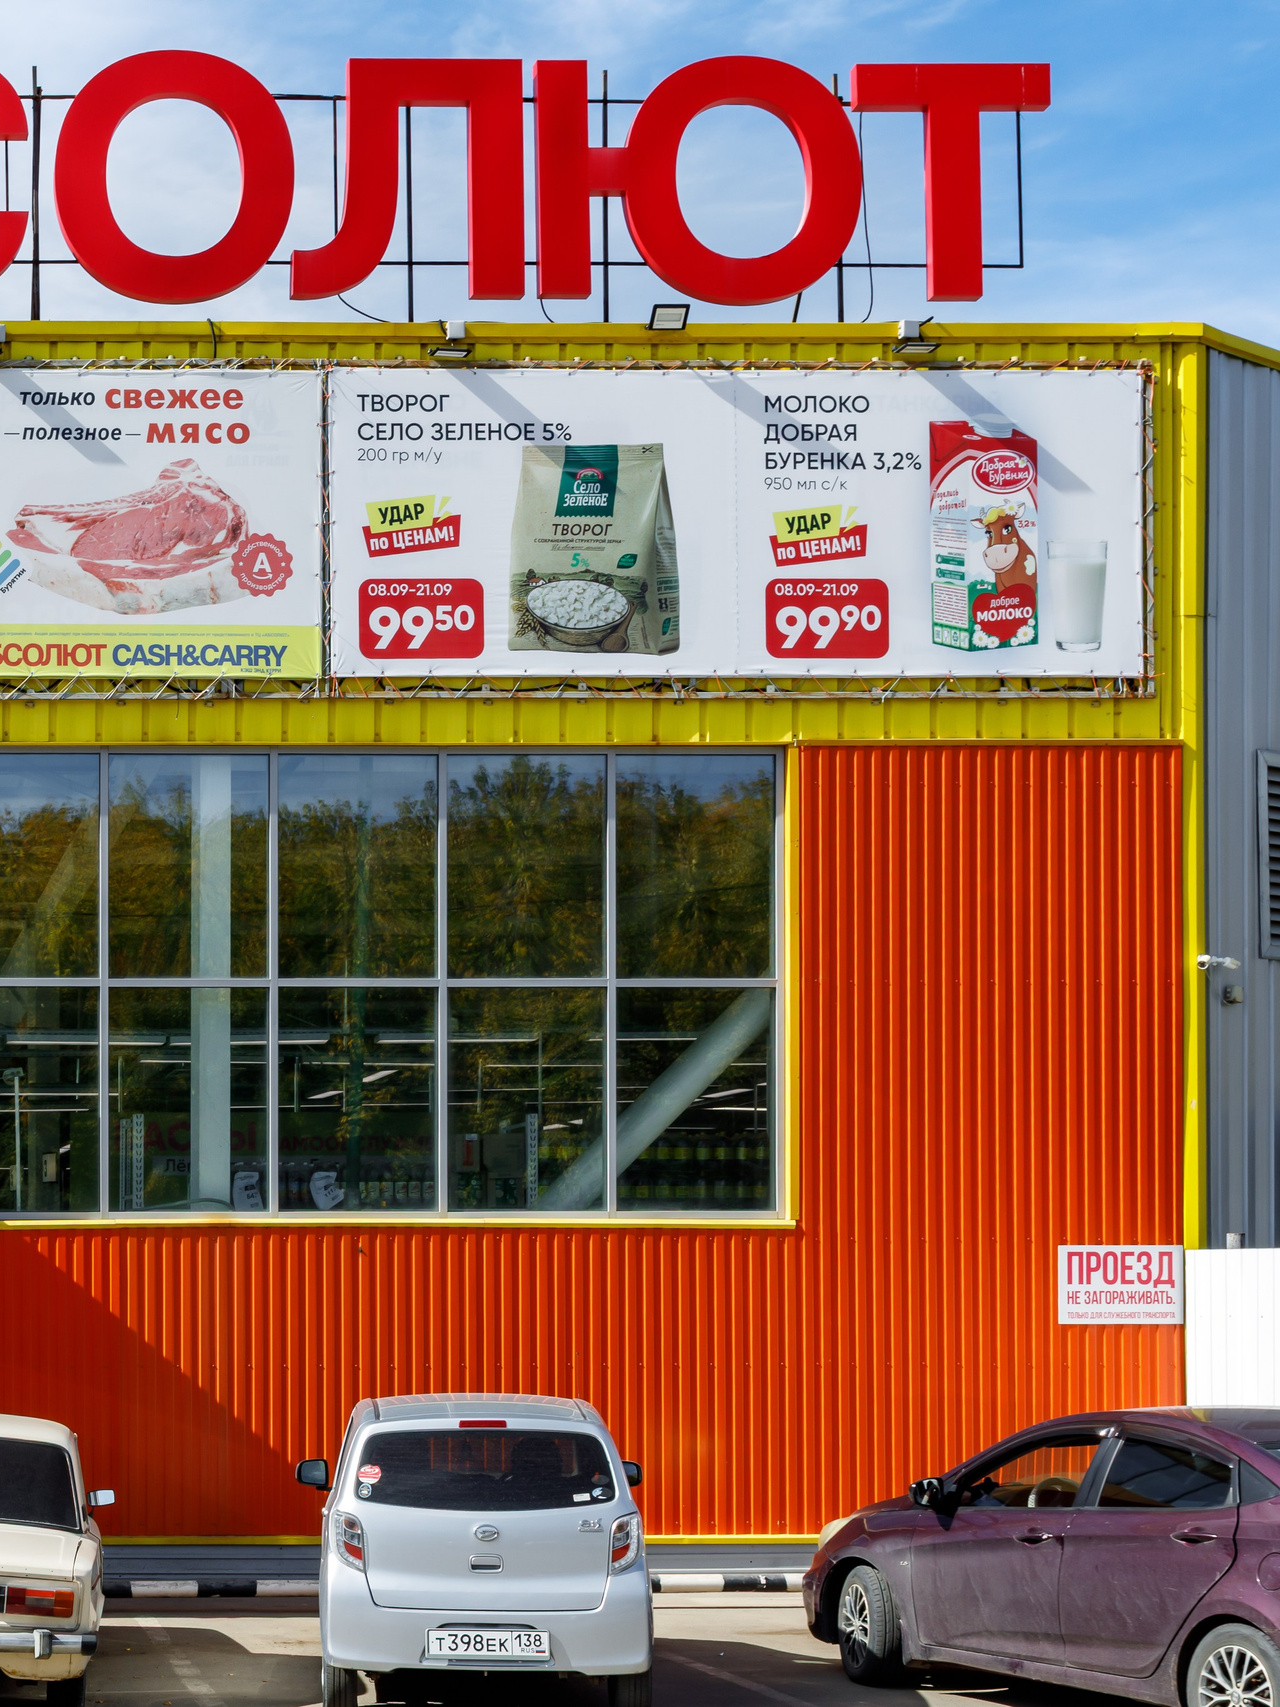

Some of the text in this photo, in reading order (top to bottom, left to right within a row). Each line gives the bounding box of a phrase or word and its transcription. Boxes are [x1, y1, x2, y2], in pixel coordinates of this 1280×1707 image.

[20, 388, 244, 410] только свежее
[357, 394, 449, 412] ТВОРОГ
[764, 395, 870, 413] МОЛОКО
[23, 422, 250, 444] полезное мясо
[358, 423, 572, 441] СЕЛО ЗЕЛЕНОЕ 5%
[764, 424, 857, 445] ДОБРАЯ
[358, 447, 442, 464] 200 гр м/у
[765, 452, 922, 473] БУРЕНКА 3,2%
[981, 458, 1015, 473] Добрая
[574, 480, 600, 493] Село
[764, 476, 847, 491] 950 мл с/к
[989, 471, 1028, 485] Бурёнка
[378, 503, 425, 525] УДАР
[552, 524, 612, 536] ТВОРОГ
[785, 513, 831, 534] УДАР
[1018, 520, 1036, 528] 3,2%
[370, 528, 455, 551] по ЦЕНАМ!
[777, 537, 861, 560] по ЦЕНАМ!
[242, 542, 283, 557] собственное
[571, 553, 589, 567] 5%
[0, 568, 26, 593] Бурятии
[240, 573, 284, 590] производство
[990, 596, 1019, 608] доброе
[977, 607, 1032, 622] МОЛОКО
[112, 643, 288, 667] CASH&CARRY
[1067, 1251, 1175, 1288] ПРОЕЗД
[1067, 1291, 1175, 1304] НЕ ЗАГОРАЖИВАТЬ.
[436, 1634, 542, 1652] Т398ЕК 138
